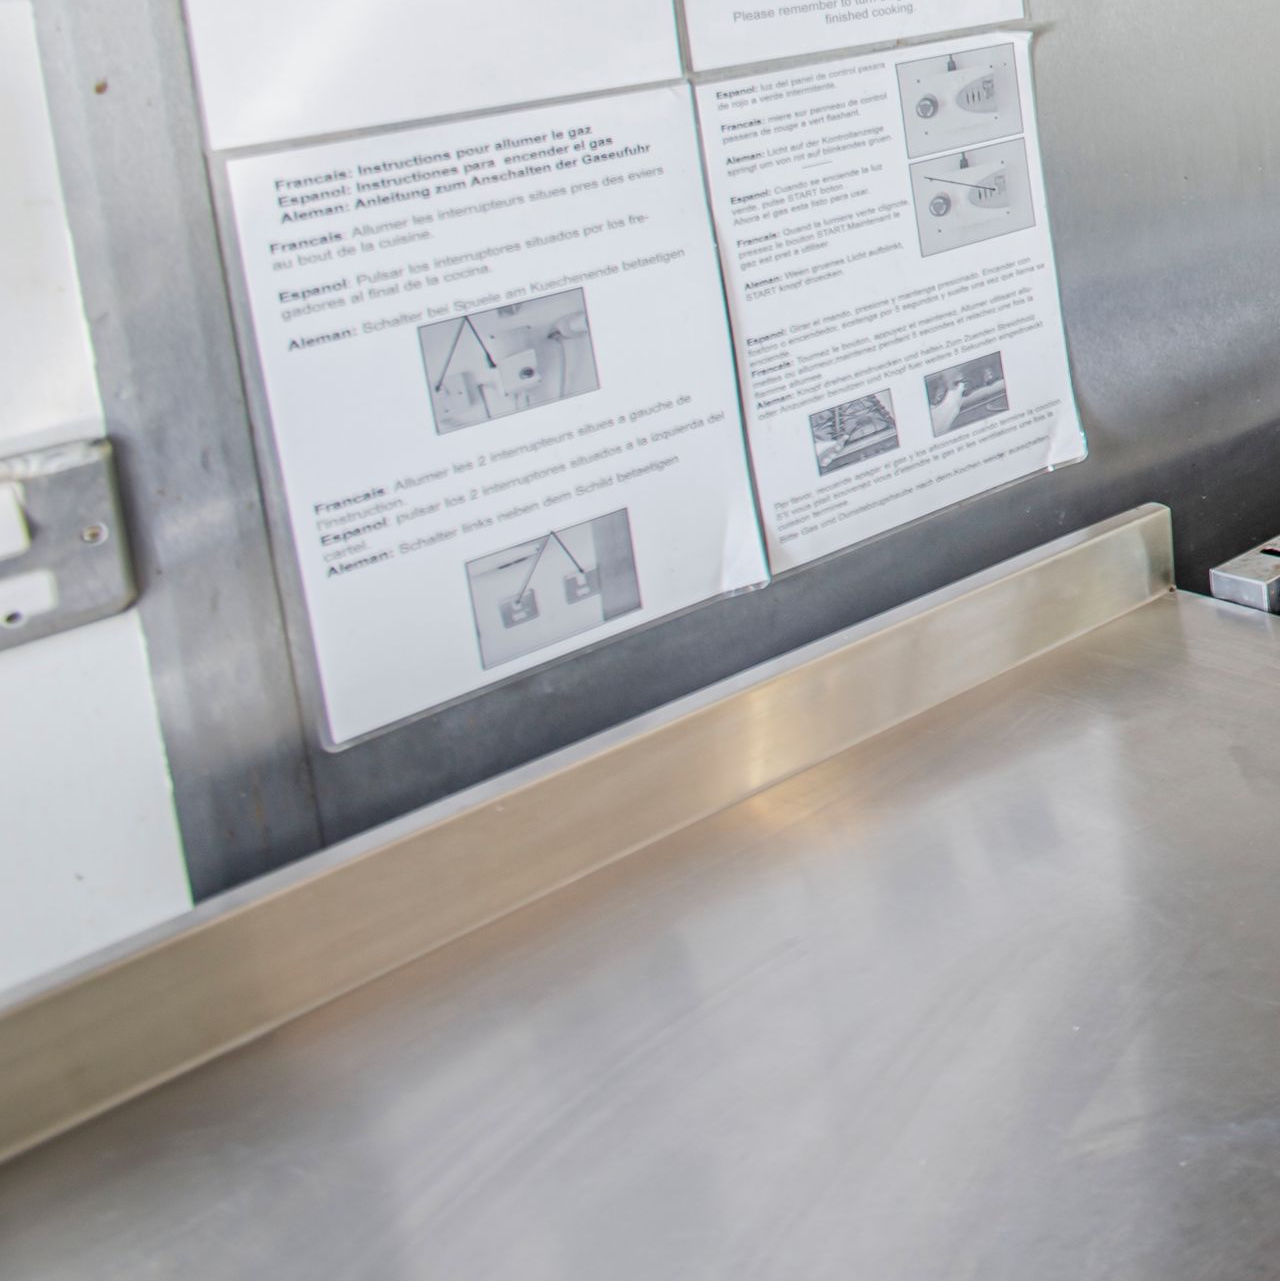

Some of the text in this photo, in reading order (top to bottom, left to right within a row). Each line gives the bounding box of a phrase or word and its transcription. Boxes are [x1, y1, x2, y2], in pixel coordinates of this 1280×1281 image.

[732, 8, 775, 22] Please
[778, 0, 837, 16] remember
[824, 8, 869, 24] finished
